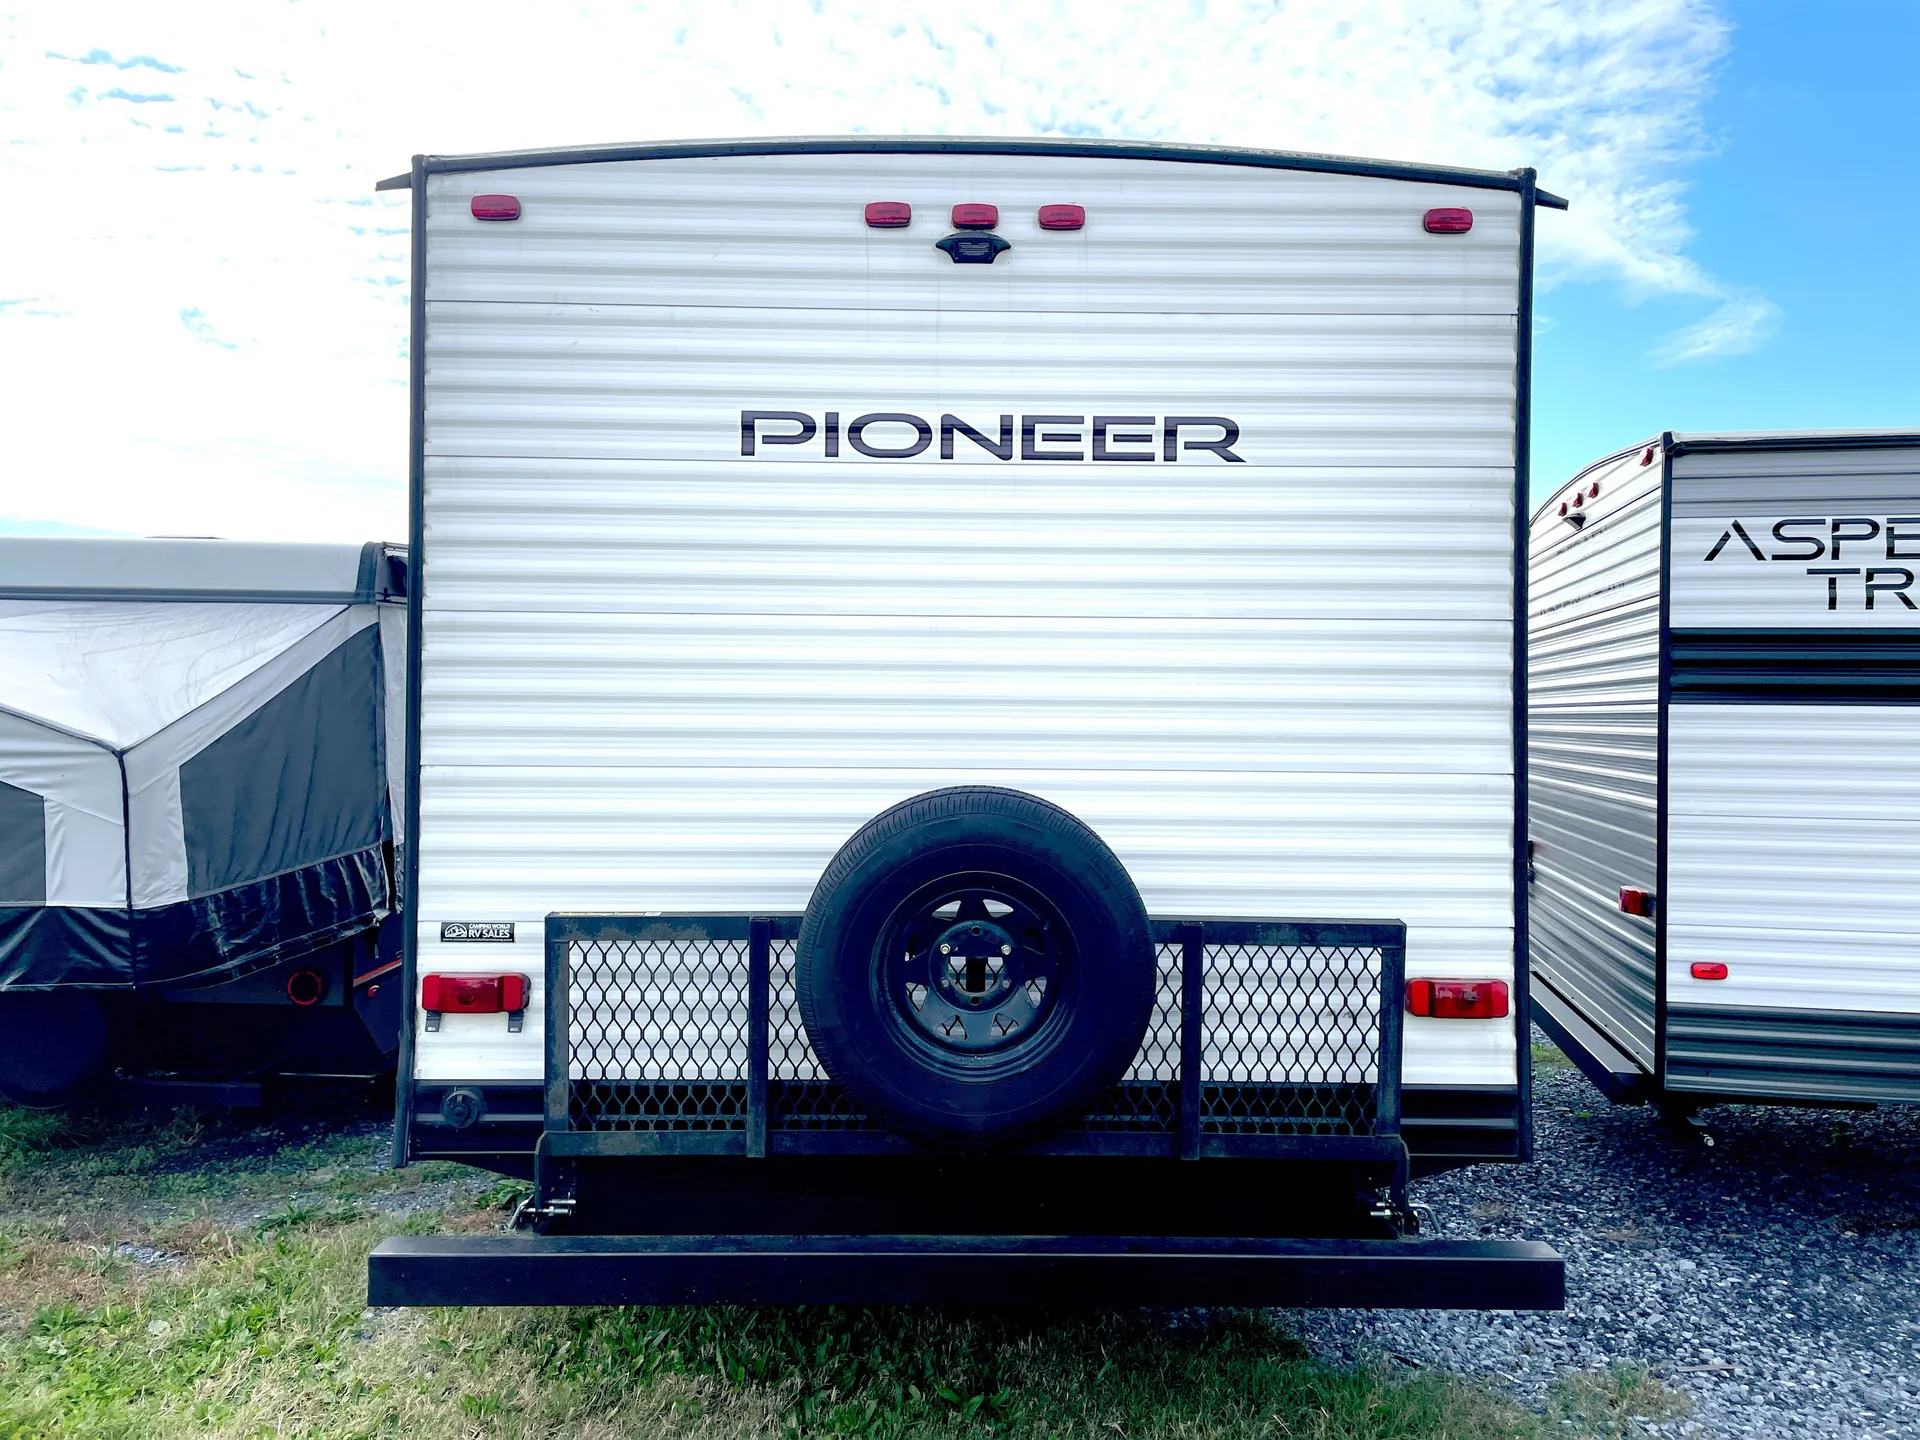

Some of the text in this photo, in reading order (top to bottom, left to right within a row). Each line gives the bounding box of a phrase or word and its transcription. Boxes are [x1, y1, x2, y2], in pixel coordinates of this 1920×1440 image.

[740, 410, 1247, 463] PIONEER
[1806, 567, 1919, 610] TR
[468, 929, 510, 938] RV SALES
